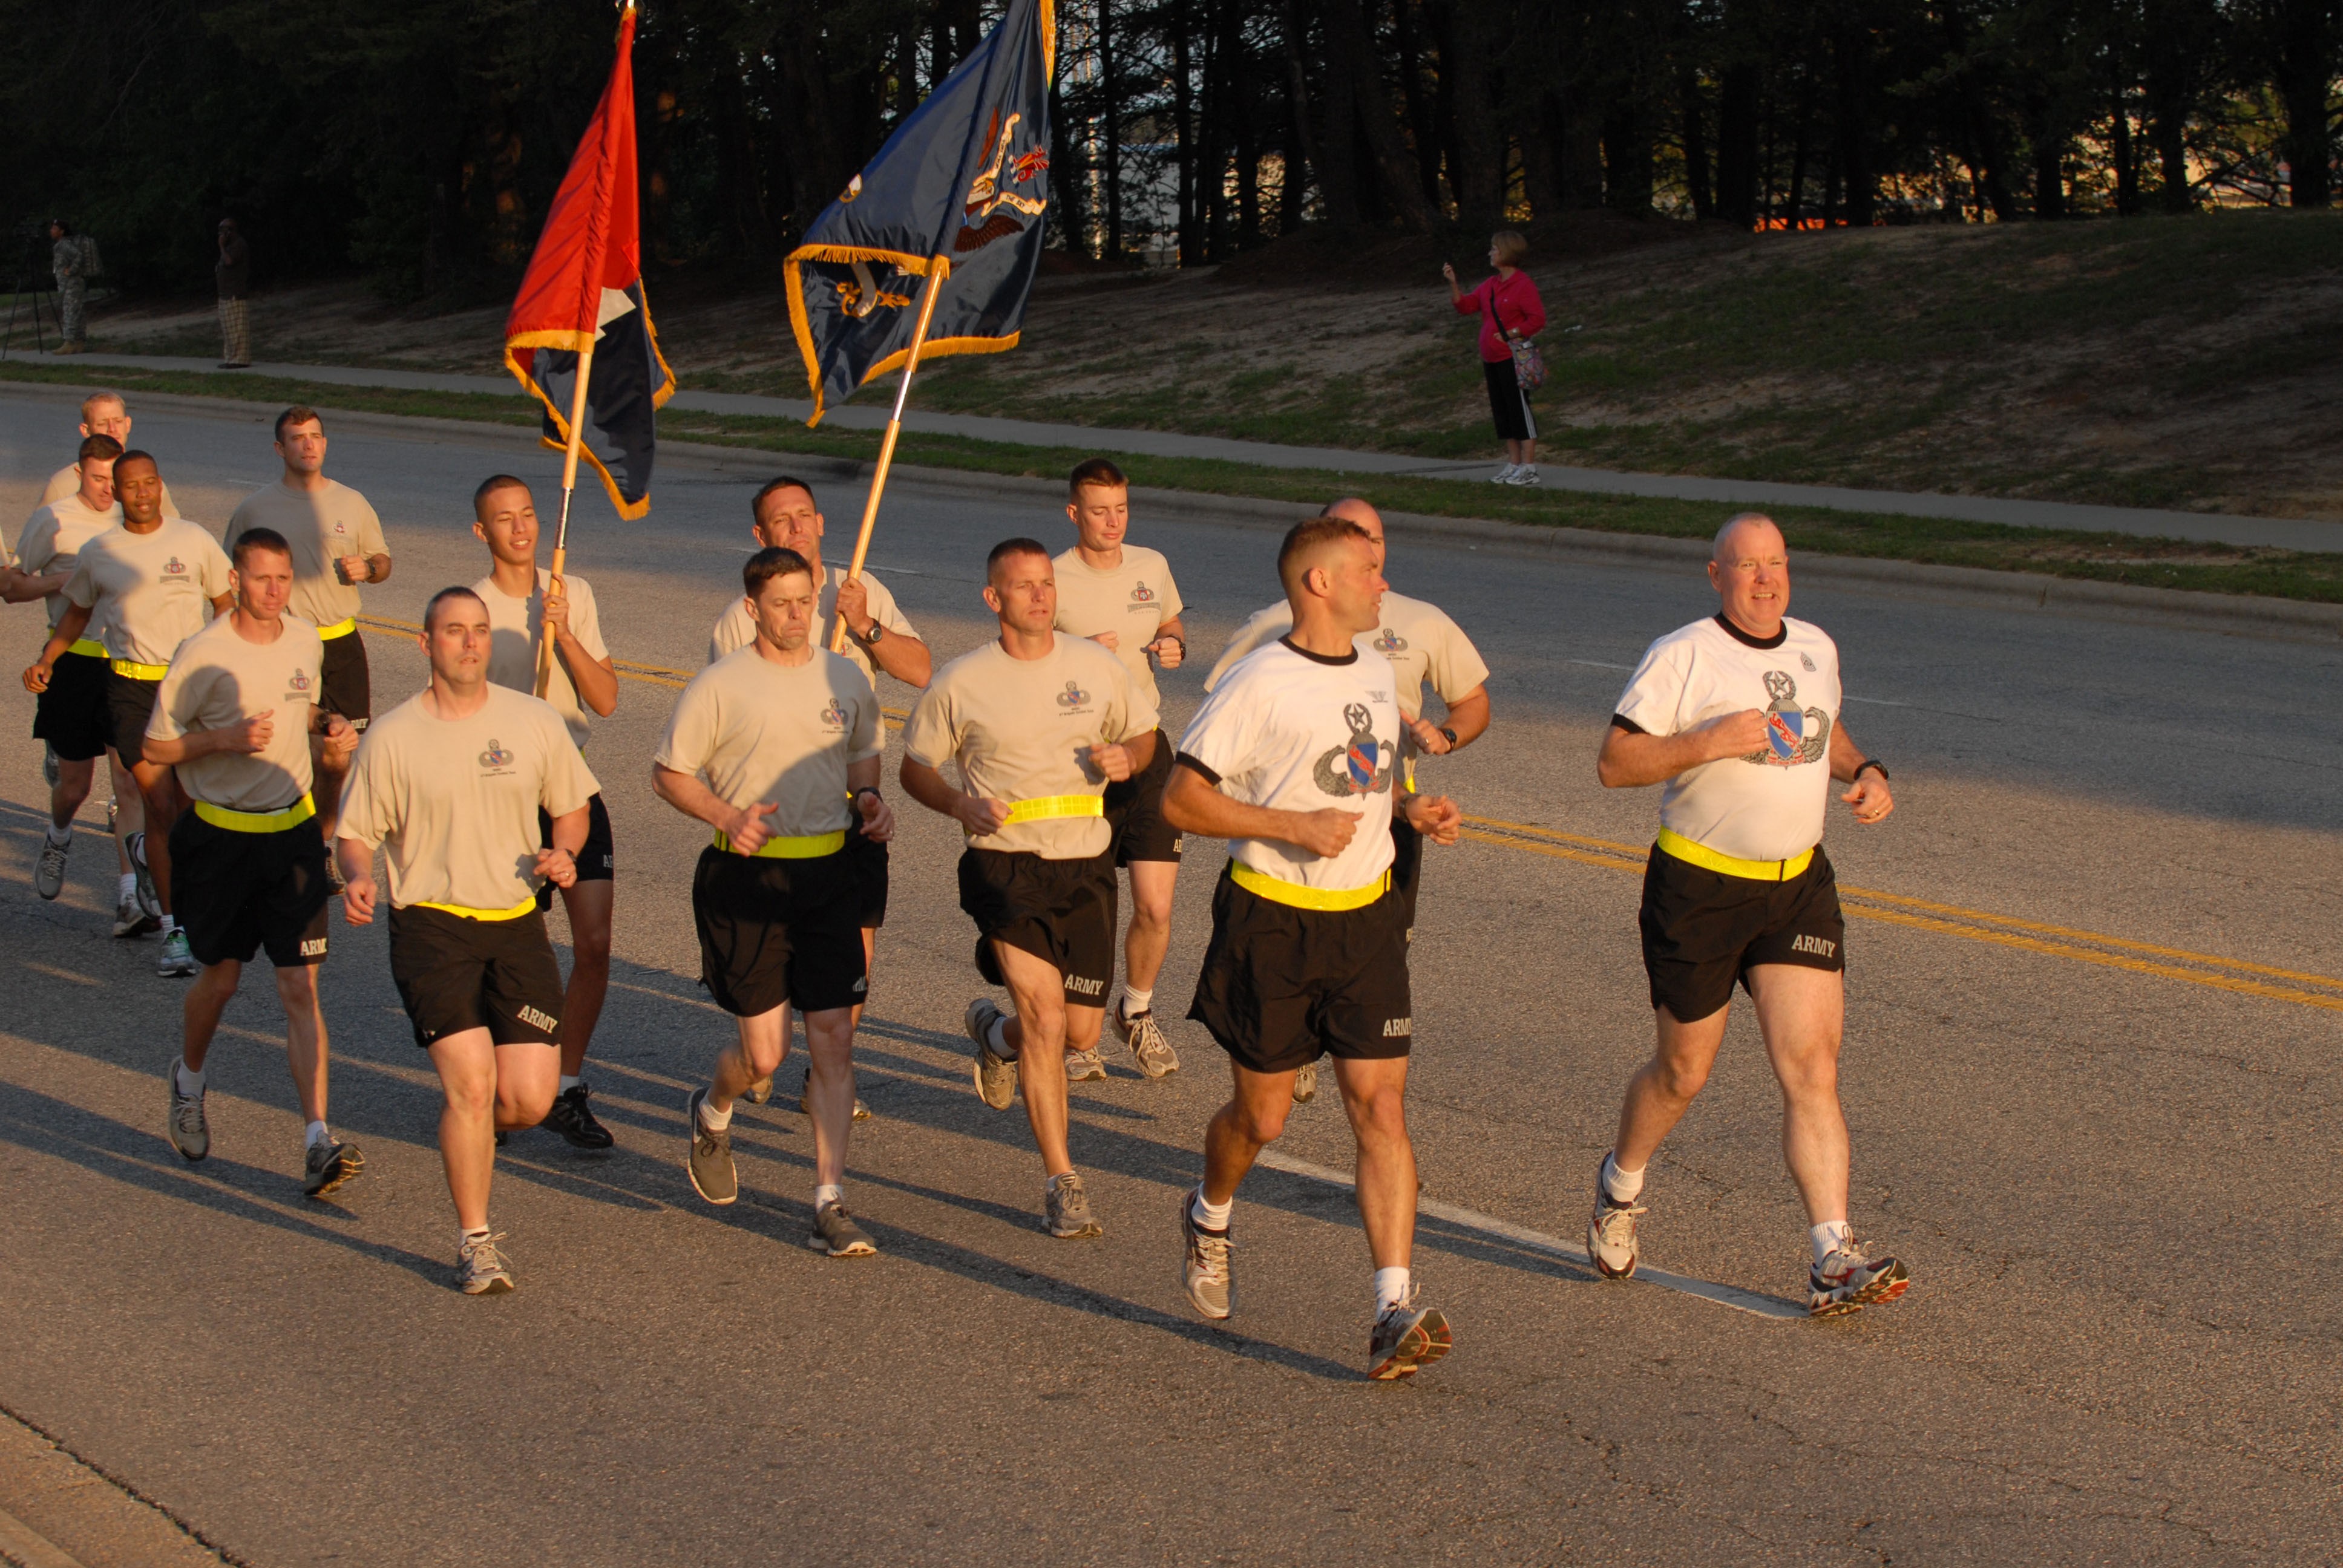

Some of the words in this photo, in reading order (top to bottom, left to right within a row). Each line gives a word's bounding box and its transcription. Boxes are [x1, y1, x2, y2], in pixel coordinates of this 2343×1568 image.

[1791, 933, 1836, 958] ARMY
[1064, 973, 1104, 996] ARMY
[517, 1004, 558, 1034] ARMY
